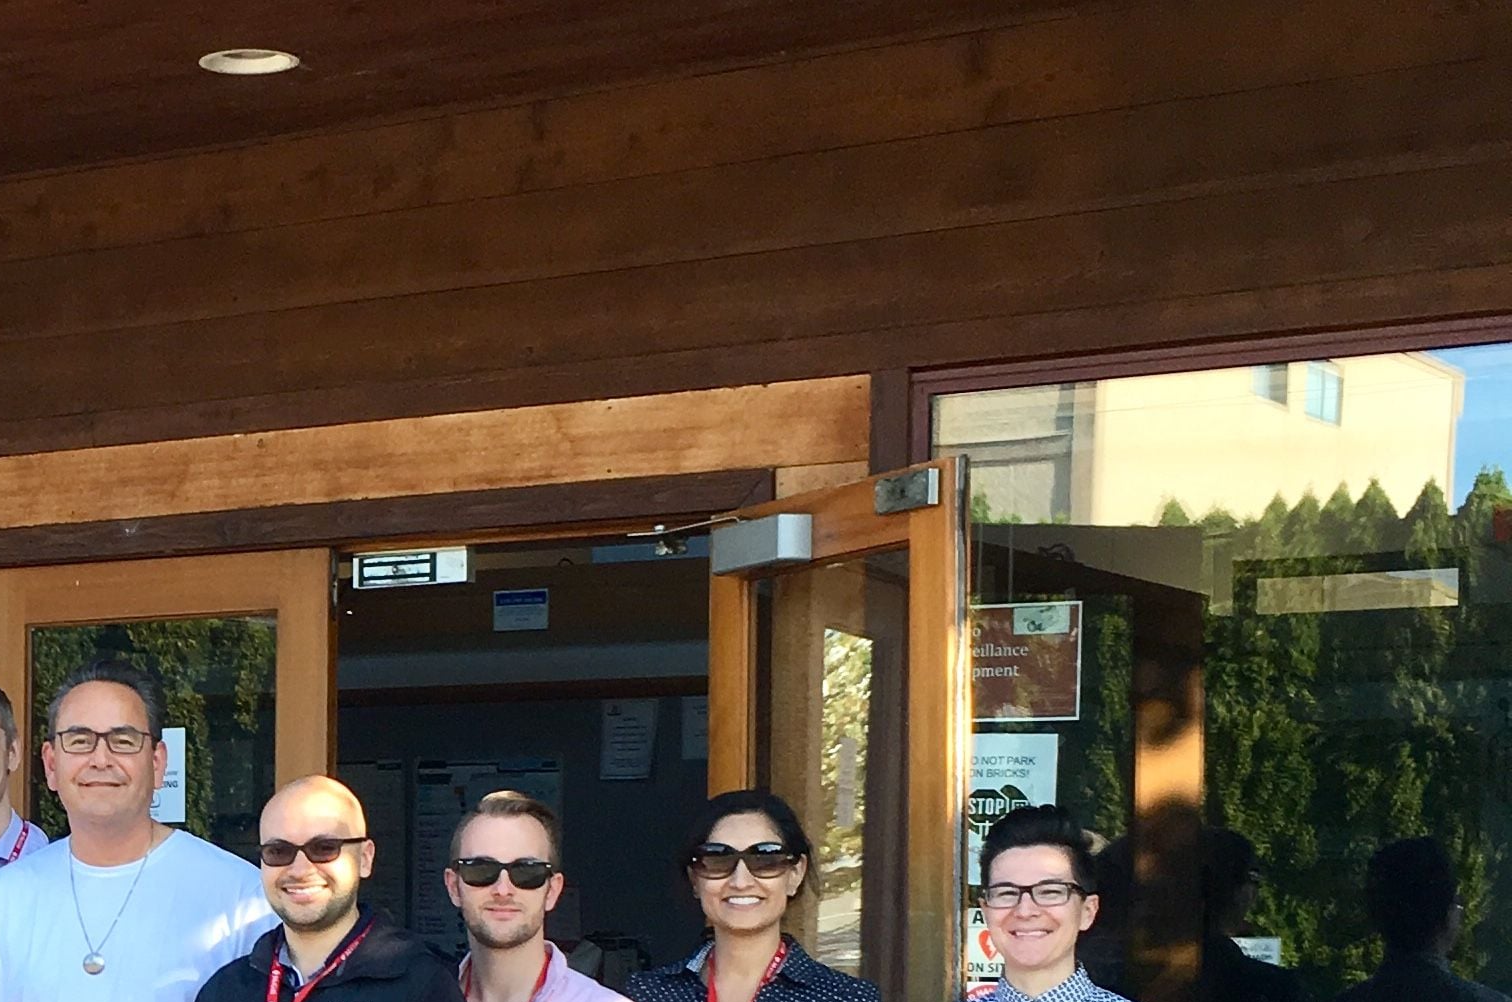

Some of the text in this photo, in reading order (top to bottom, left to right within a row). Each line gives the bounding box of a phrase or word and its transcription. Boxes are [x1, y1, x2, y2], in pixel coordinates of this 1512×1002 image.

[972, 643, 1029, 658] eillance
[972, 664, 1021, 682] pment
[981, 756, 1005, 766] NOT
[1007, 756, 1037, 766] PARK
[968, 797, 1005, 815] STOP
[968, 962, 984, 973] ON
